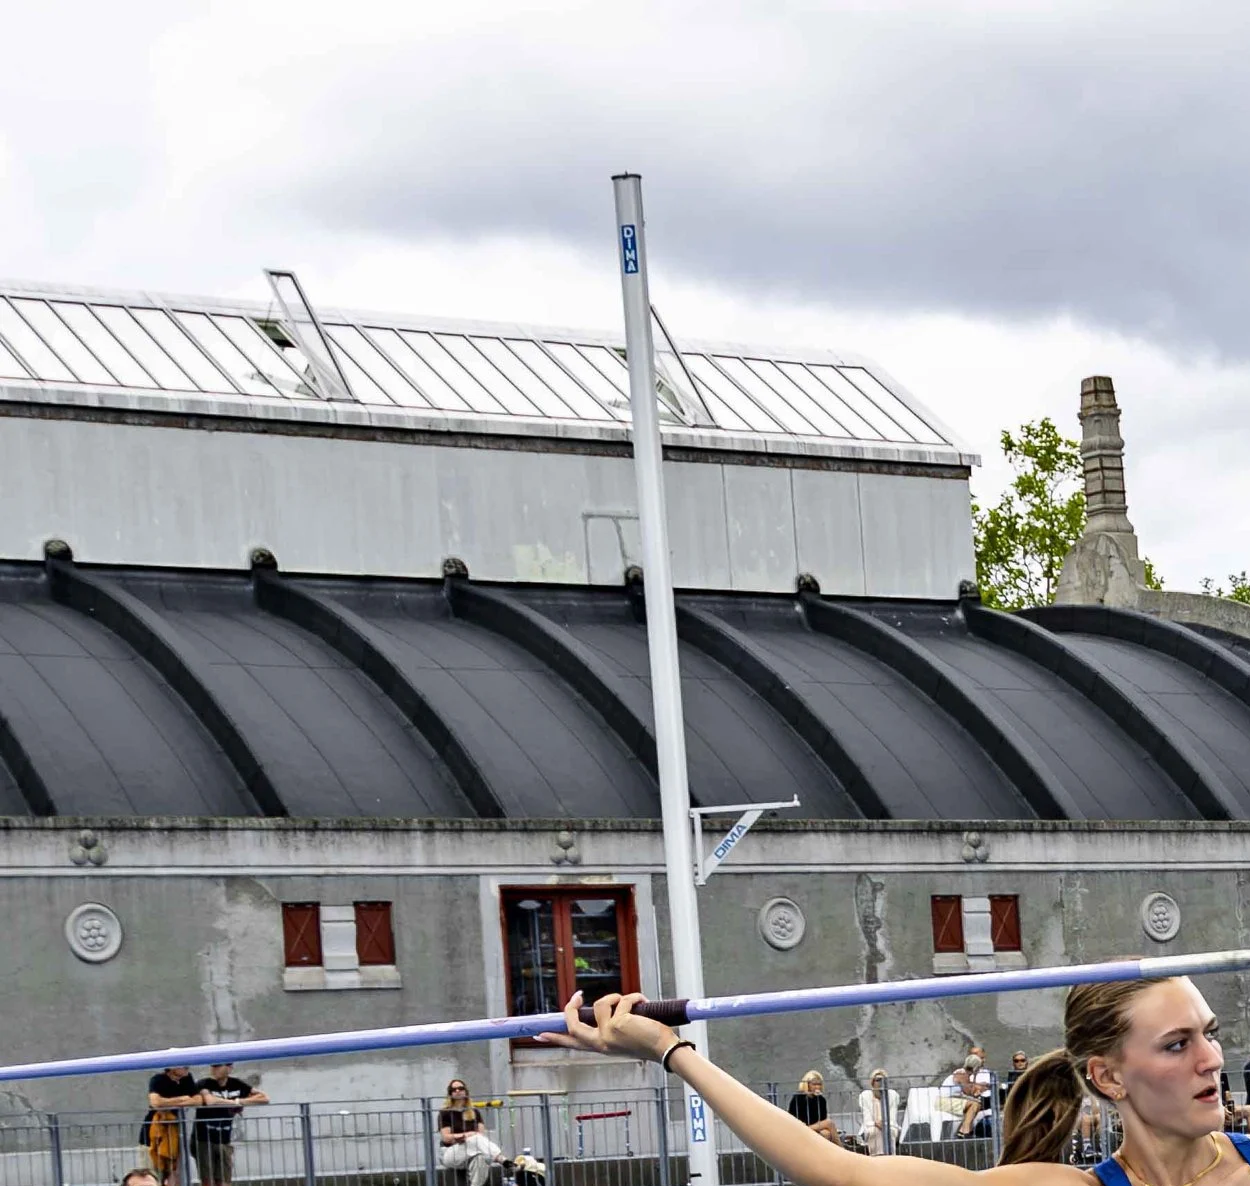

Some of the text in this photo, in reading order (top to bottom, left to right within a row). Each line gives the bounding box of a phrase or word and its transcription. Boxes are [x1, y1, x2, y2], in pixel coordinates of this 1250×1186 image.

[623, 226, 637, 272] DIMA
[714, 825, 747, 860] DIMA
[691, 1096, 705, 1141] DIMA
